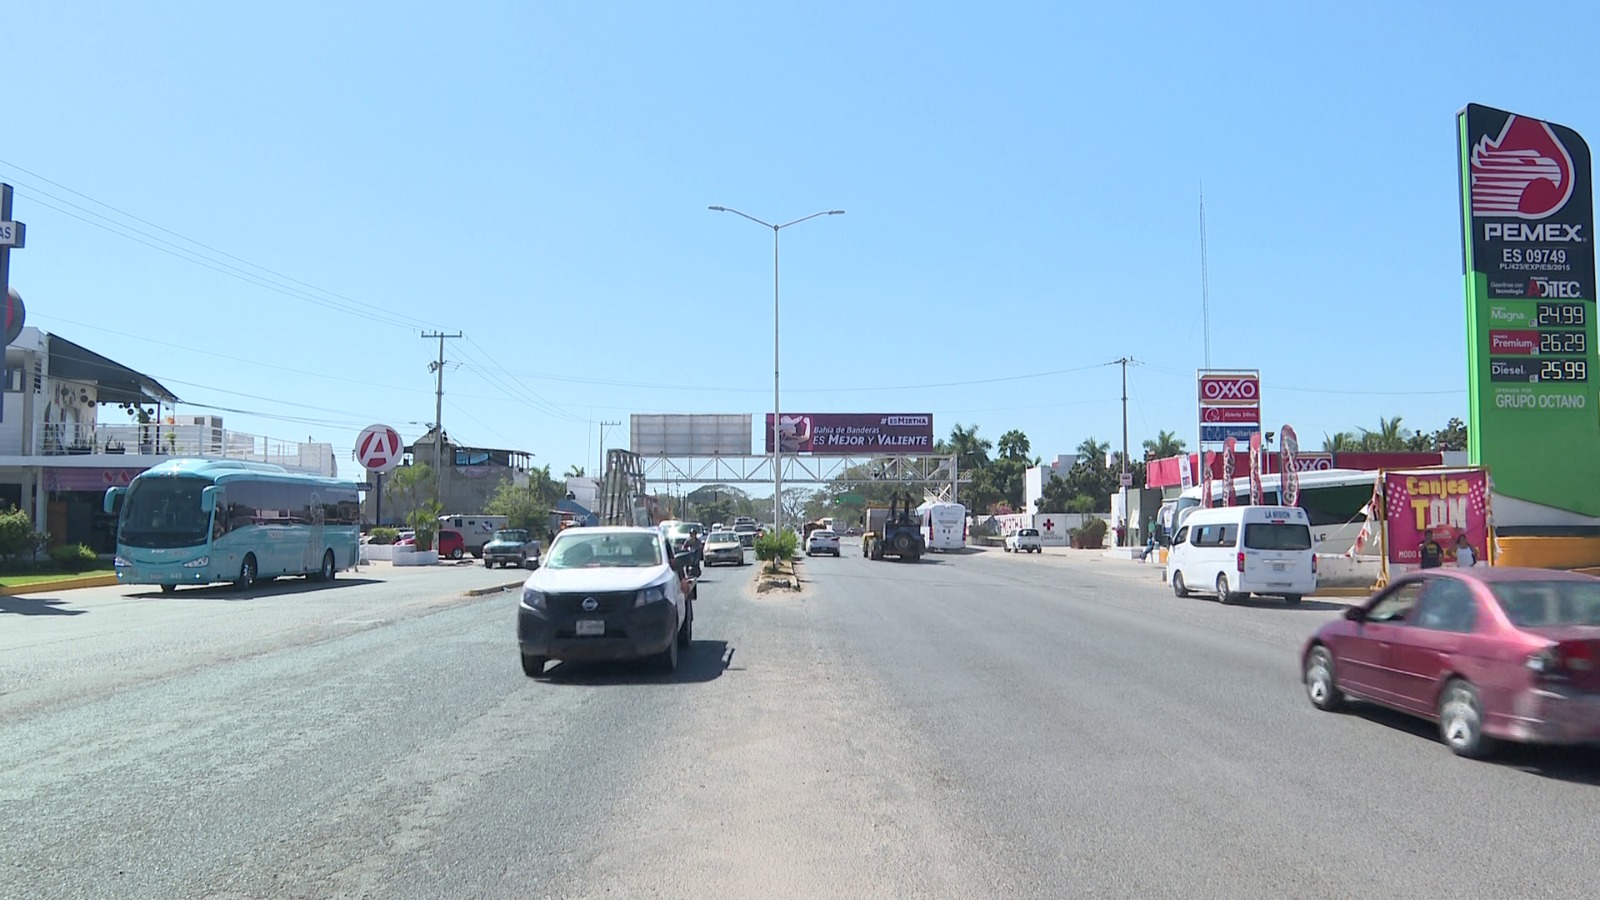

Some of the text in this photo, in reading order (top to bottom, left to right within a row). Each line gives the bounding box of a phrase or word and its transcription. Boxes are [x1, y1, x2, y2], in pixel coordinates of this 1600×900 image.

[1484, 223, 1582, 242] PEMEX
[1503, 249, 1566, 263] ES 09749
[1491, 310, 1524, 322] Magna
[1539, 306, 1584, 324] 24.99
[1493, 338, 1532, 348] Premium
[1541, 334, 1585, 352] 26.29
[1491, 365, 1524, 375] Diesel
[1541, 361, 1586, 380] 25.99
[1204, 380, 1256, 399] OXXO
[1495, 394, 1586, 408] GRUPO OCTANO
[814, 426, 834, 434] Bahía
[847, 426, 880, 434] Banderas
[813, 434, 928, 446] ES MEJOR Y VALIENTE
[1406, 474, 1469, 500] Canjea
